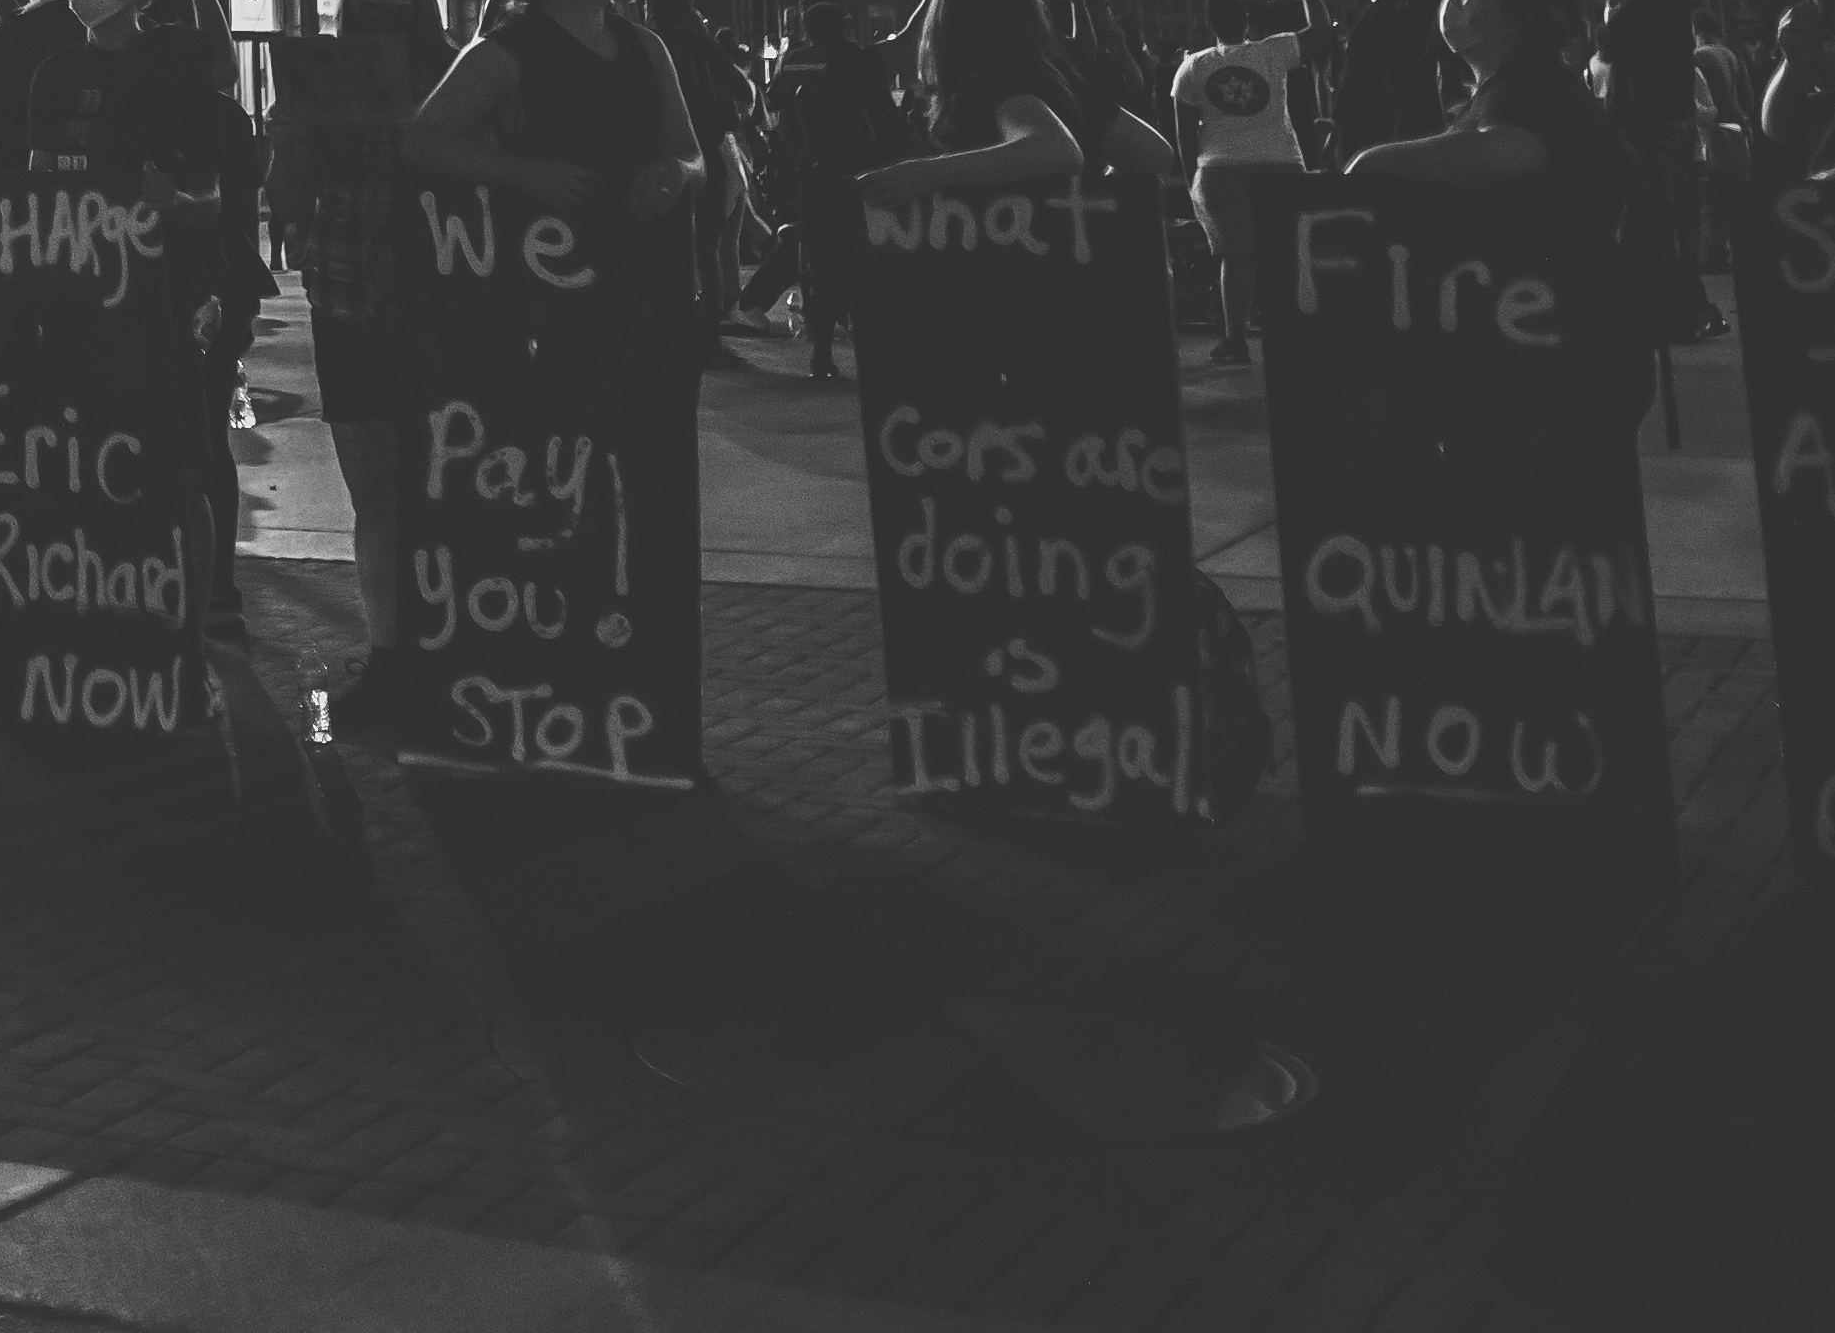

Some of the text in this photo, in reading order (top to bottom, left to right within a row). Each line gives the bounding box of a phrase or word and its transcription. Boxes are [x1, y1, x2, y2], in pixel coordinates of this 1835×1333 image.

[420, 185, 596, 288] We
[1294, 208, 1563, 347] Fire
[424, 399, 593, 545] Pay
[1062, 425, 1186, 505] are
[895, 495, 1158, 648] doing
[1304, 534, 1645, 648] QUINLAN
[20, 652, 182, 735] NOW
[983, 638, 1062, 694] is
[450, 674, 655, 781] STOP
[1335, 694, 1605, 799] NOW
